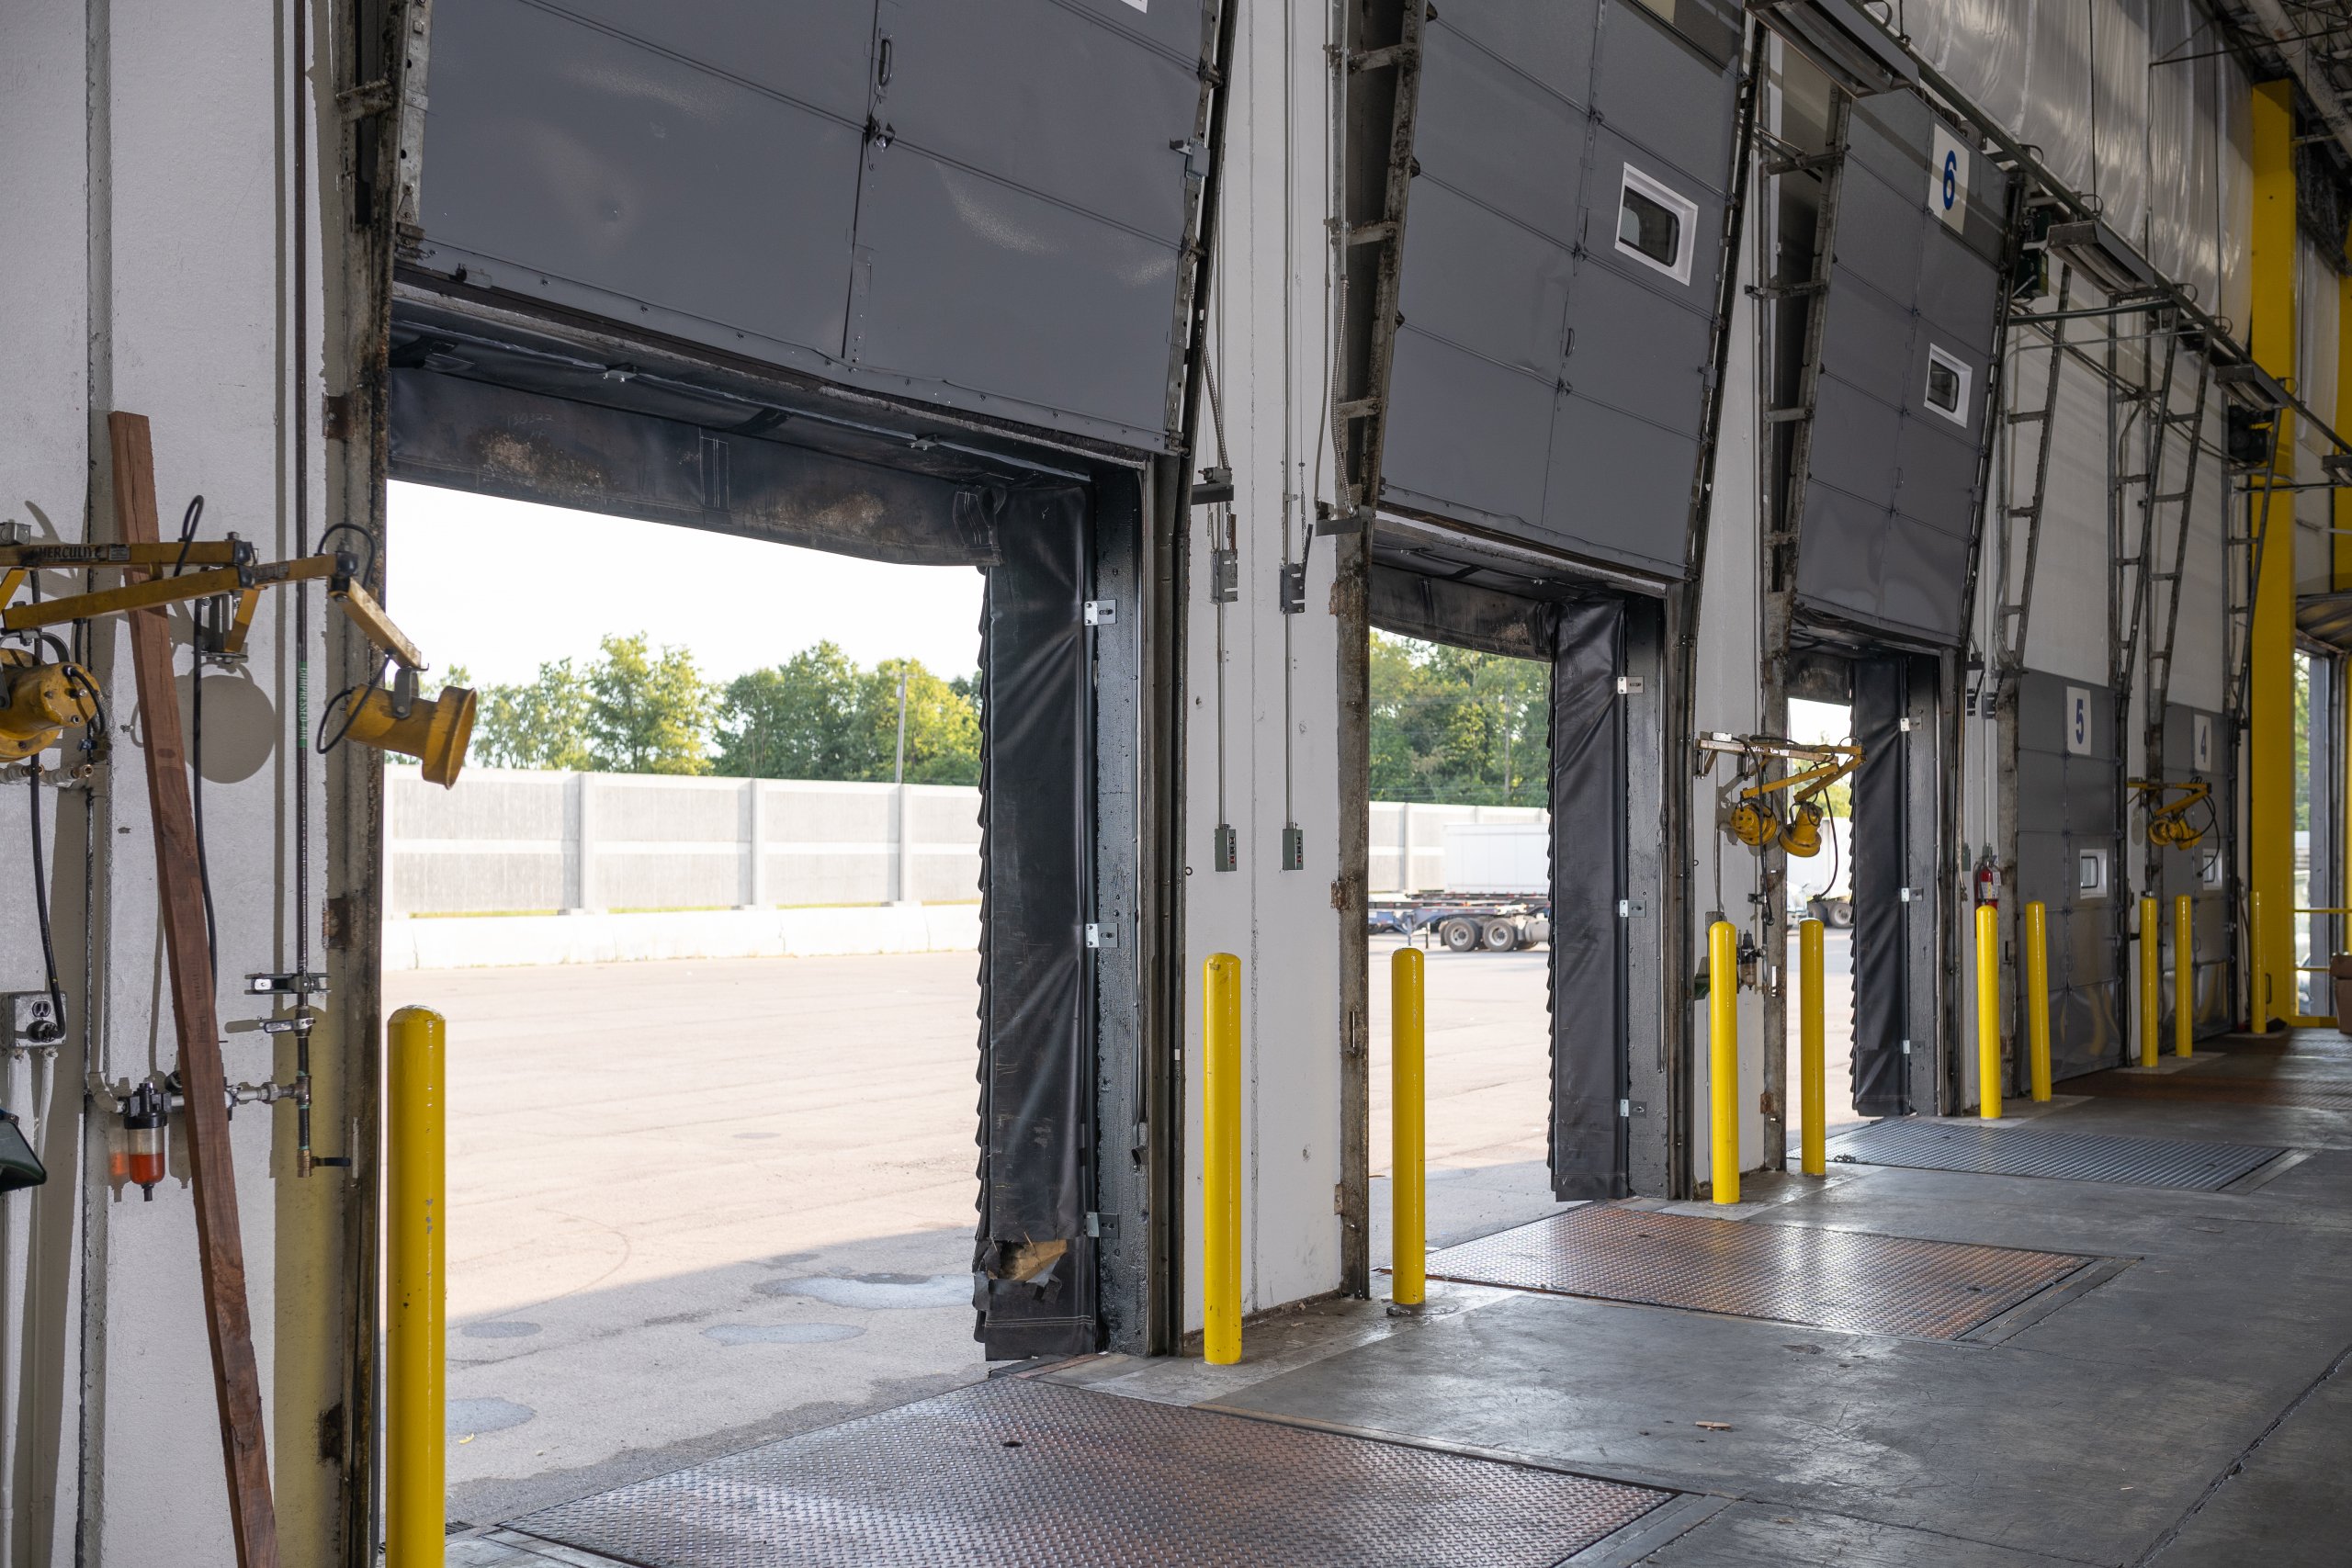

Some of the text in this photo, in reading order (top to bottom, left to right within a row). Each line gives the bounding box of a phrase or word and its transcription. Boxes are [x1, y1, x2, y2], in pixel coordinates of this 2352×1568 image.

[1942, 150, 1957, 210] 6
[299, 668, 308, 739] COMPRESSED AIR
[2075, 698, 2084, 745] 5
[2200, 725, 2207, 763] 4
